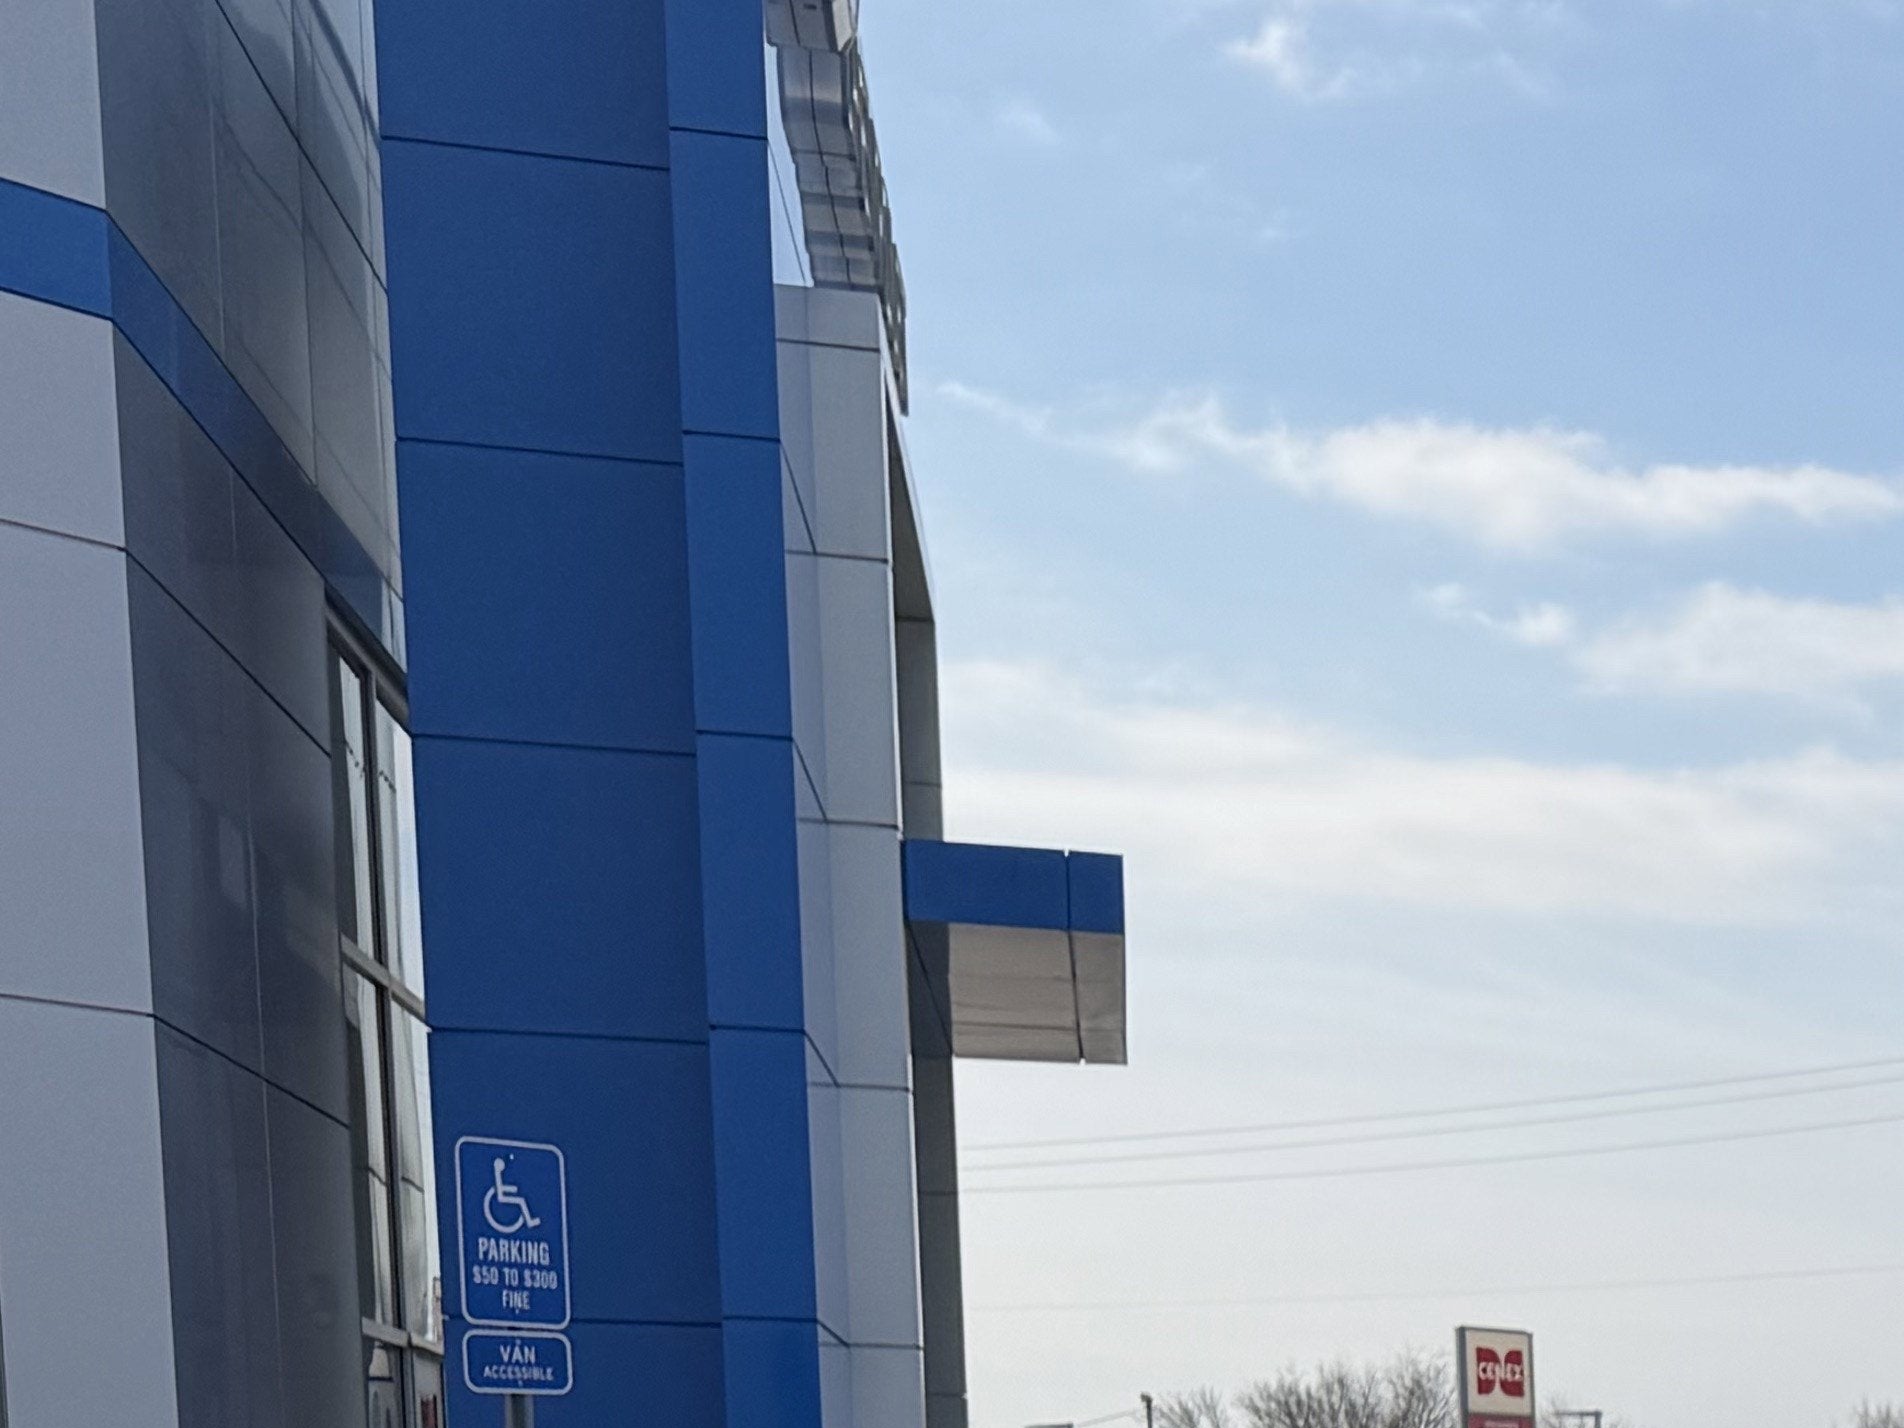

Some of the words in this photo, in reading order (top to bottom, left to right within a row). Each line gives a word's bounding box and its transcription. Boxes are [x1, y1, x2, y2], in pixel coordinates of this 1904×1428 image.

[477, 1236, 550, 1266] PARKING
[472, 1265, 499, 1286] $50
[502, 1267, 519, 1287] TO
[523, 1267, 558, 1290] $300
[501, 1289, 530, 1310] FINE
[500, 1344, 536, 1364] VAN
[483, 1364, 554, 1381] ACCESSIBLE
